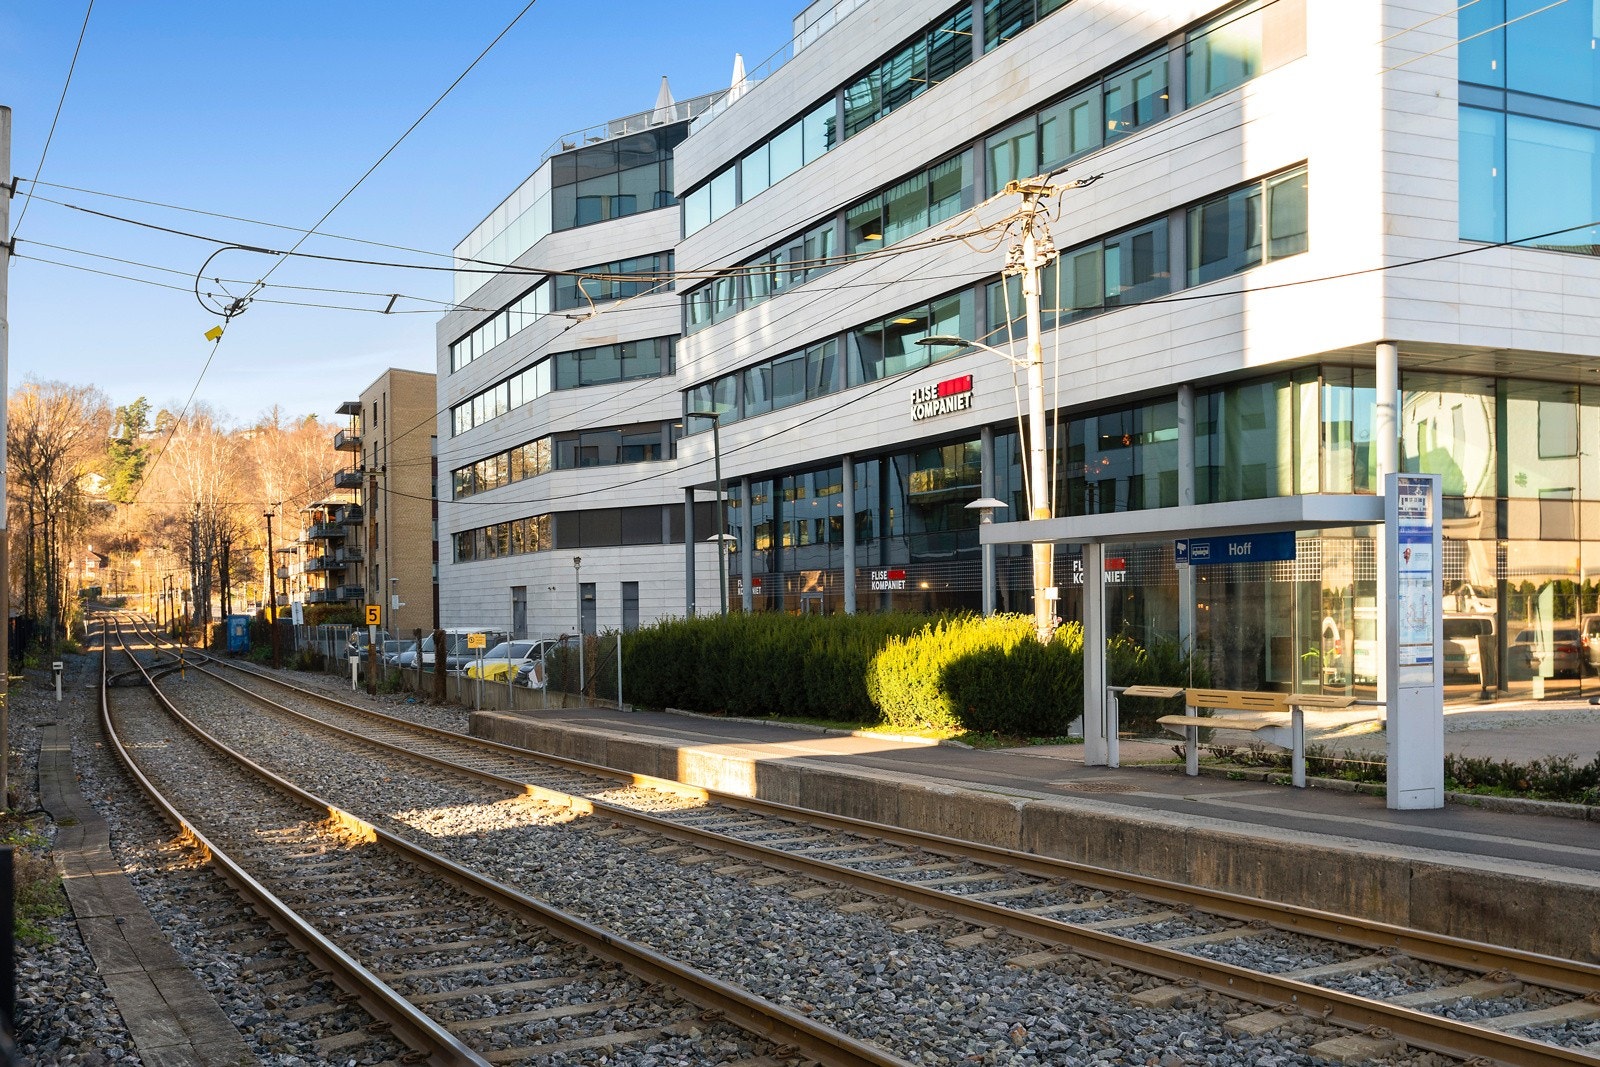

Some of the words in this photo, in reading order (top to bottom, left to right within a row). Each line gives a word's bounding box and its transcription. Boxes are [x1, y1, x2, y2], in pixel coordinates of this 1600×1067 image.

[910, 384, 938, 404] FLISE
[910, 391, 973, 421] KOMPANIET
[1229, 542, 1252, 556] Hoff
[871, 571, 888, 580] FLISE
[1073, 571, 1126, 584] KONIET
[871, 580, 906, 590] KOMPANIET
[369, 608, 378, 621] 5
